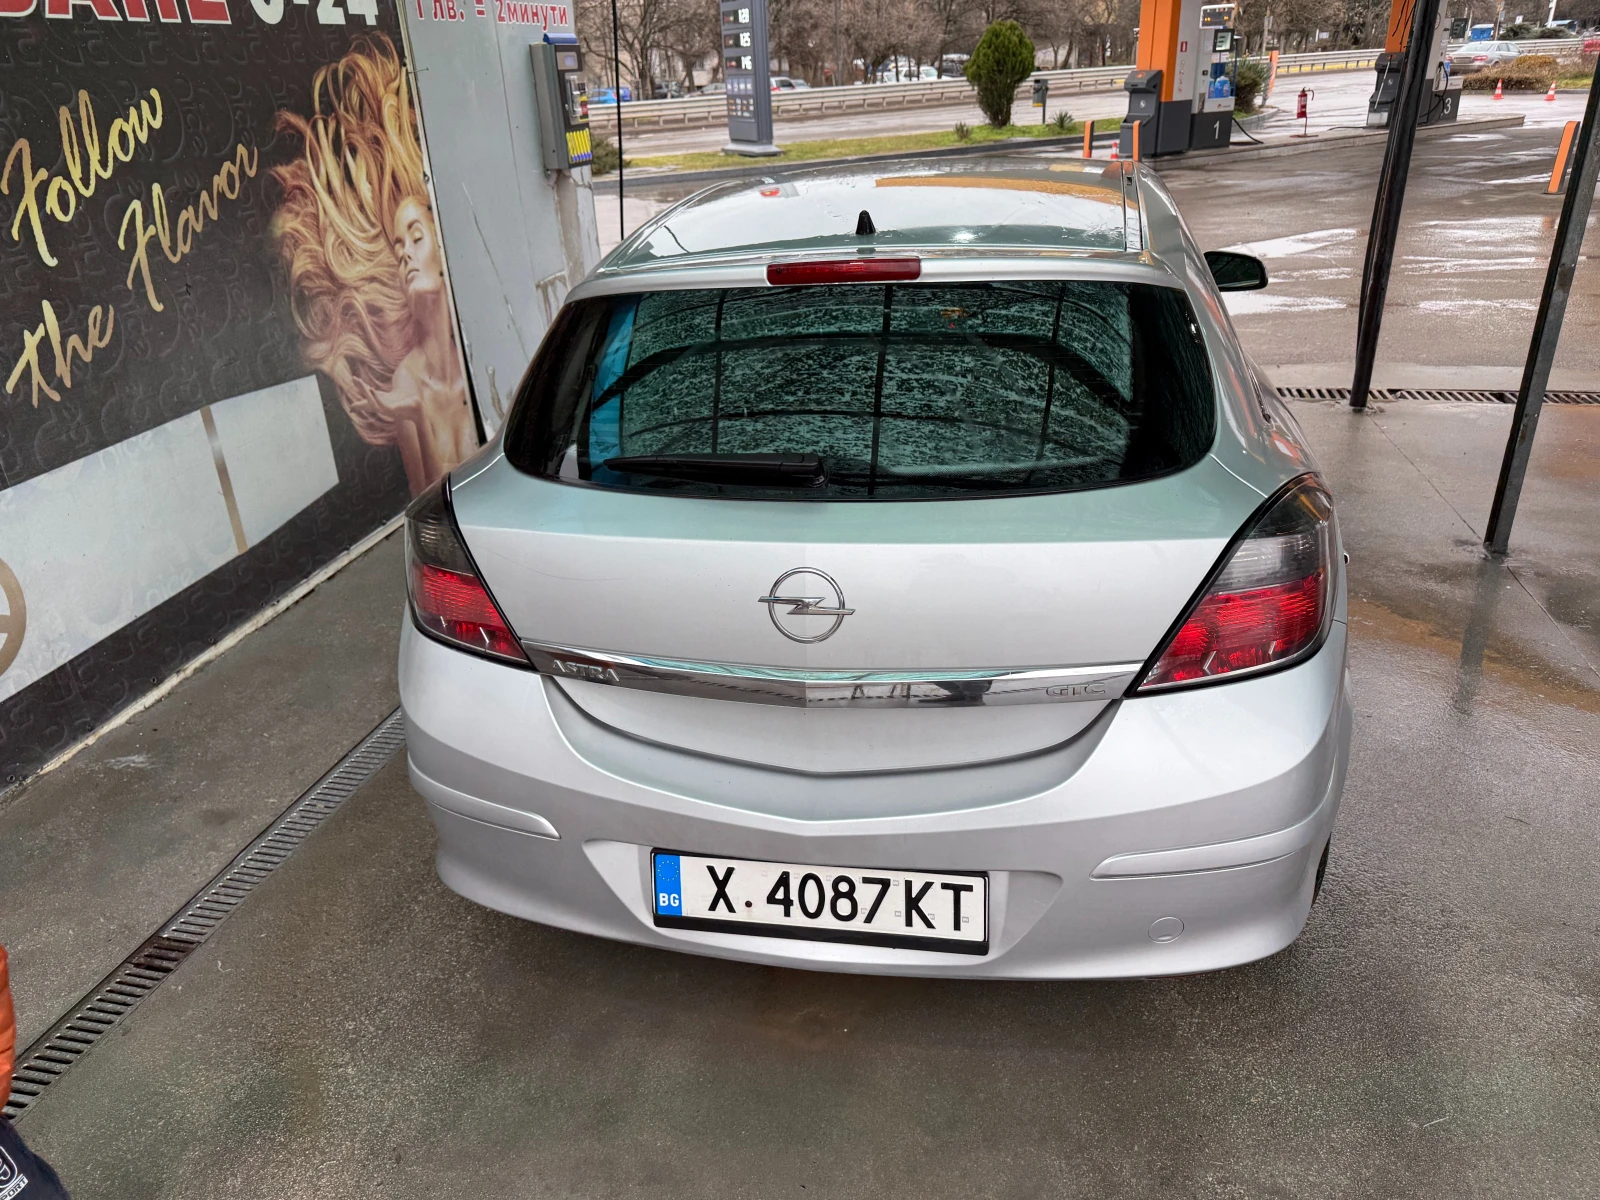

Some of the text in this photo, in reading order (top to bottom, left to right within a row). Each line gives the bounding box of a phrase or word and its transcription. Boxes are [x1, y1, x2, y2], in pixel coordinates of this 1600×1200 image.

[1443, 97, 1452, 115] 3
[1213, 119, 1221, 140] 1
[0, 88, 163, 267] Follow
[5, 143, 259, 409] the Flavor
[551, 659, 620, 682] ASTRA
[1046, 682, 1106, 698] GTC
[659, 893, 680, 907] BG
